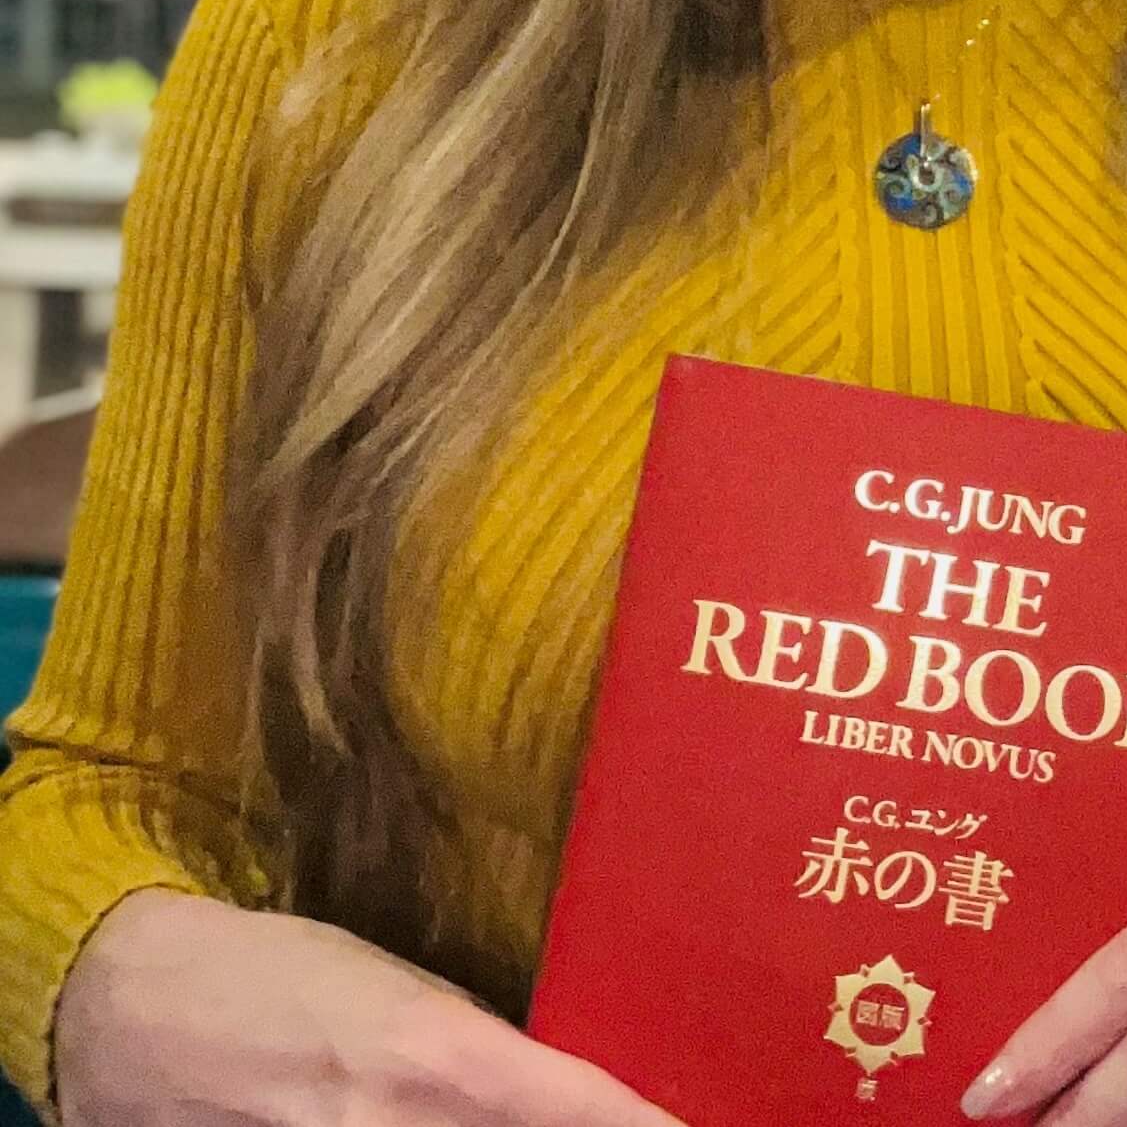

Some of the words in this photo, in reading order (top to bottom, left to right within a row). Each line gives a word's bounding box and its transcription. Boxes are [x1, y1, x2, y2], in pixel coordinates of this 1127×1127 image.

[866, 539, 1051, 638] THE
[681, 599, 890, 699] RED
[800, 710, 914, 760] LIBER
[920, 730, 1057, 783] NOVUS
[794, 826, 1014, 931] 赤の書
